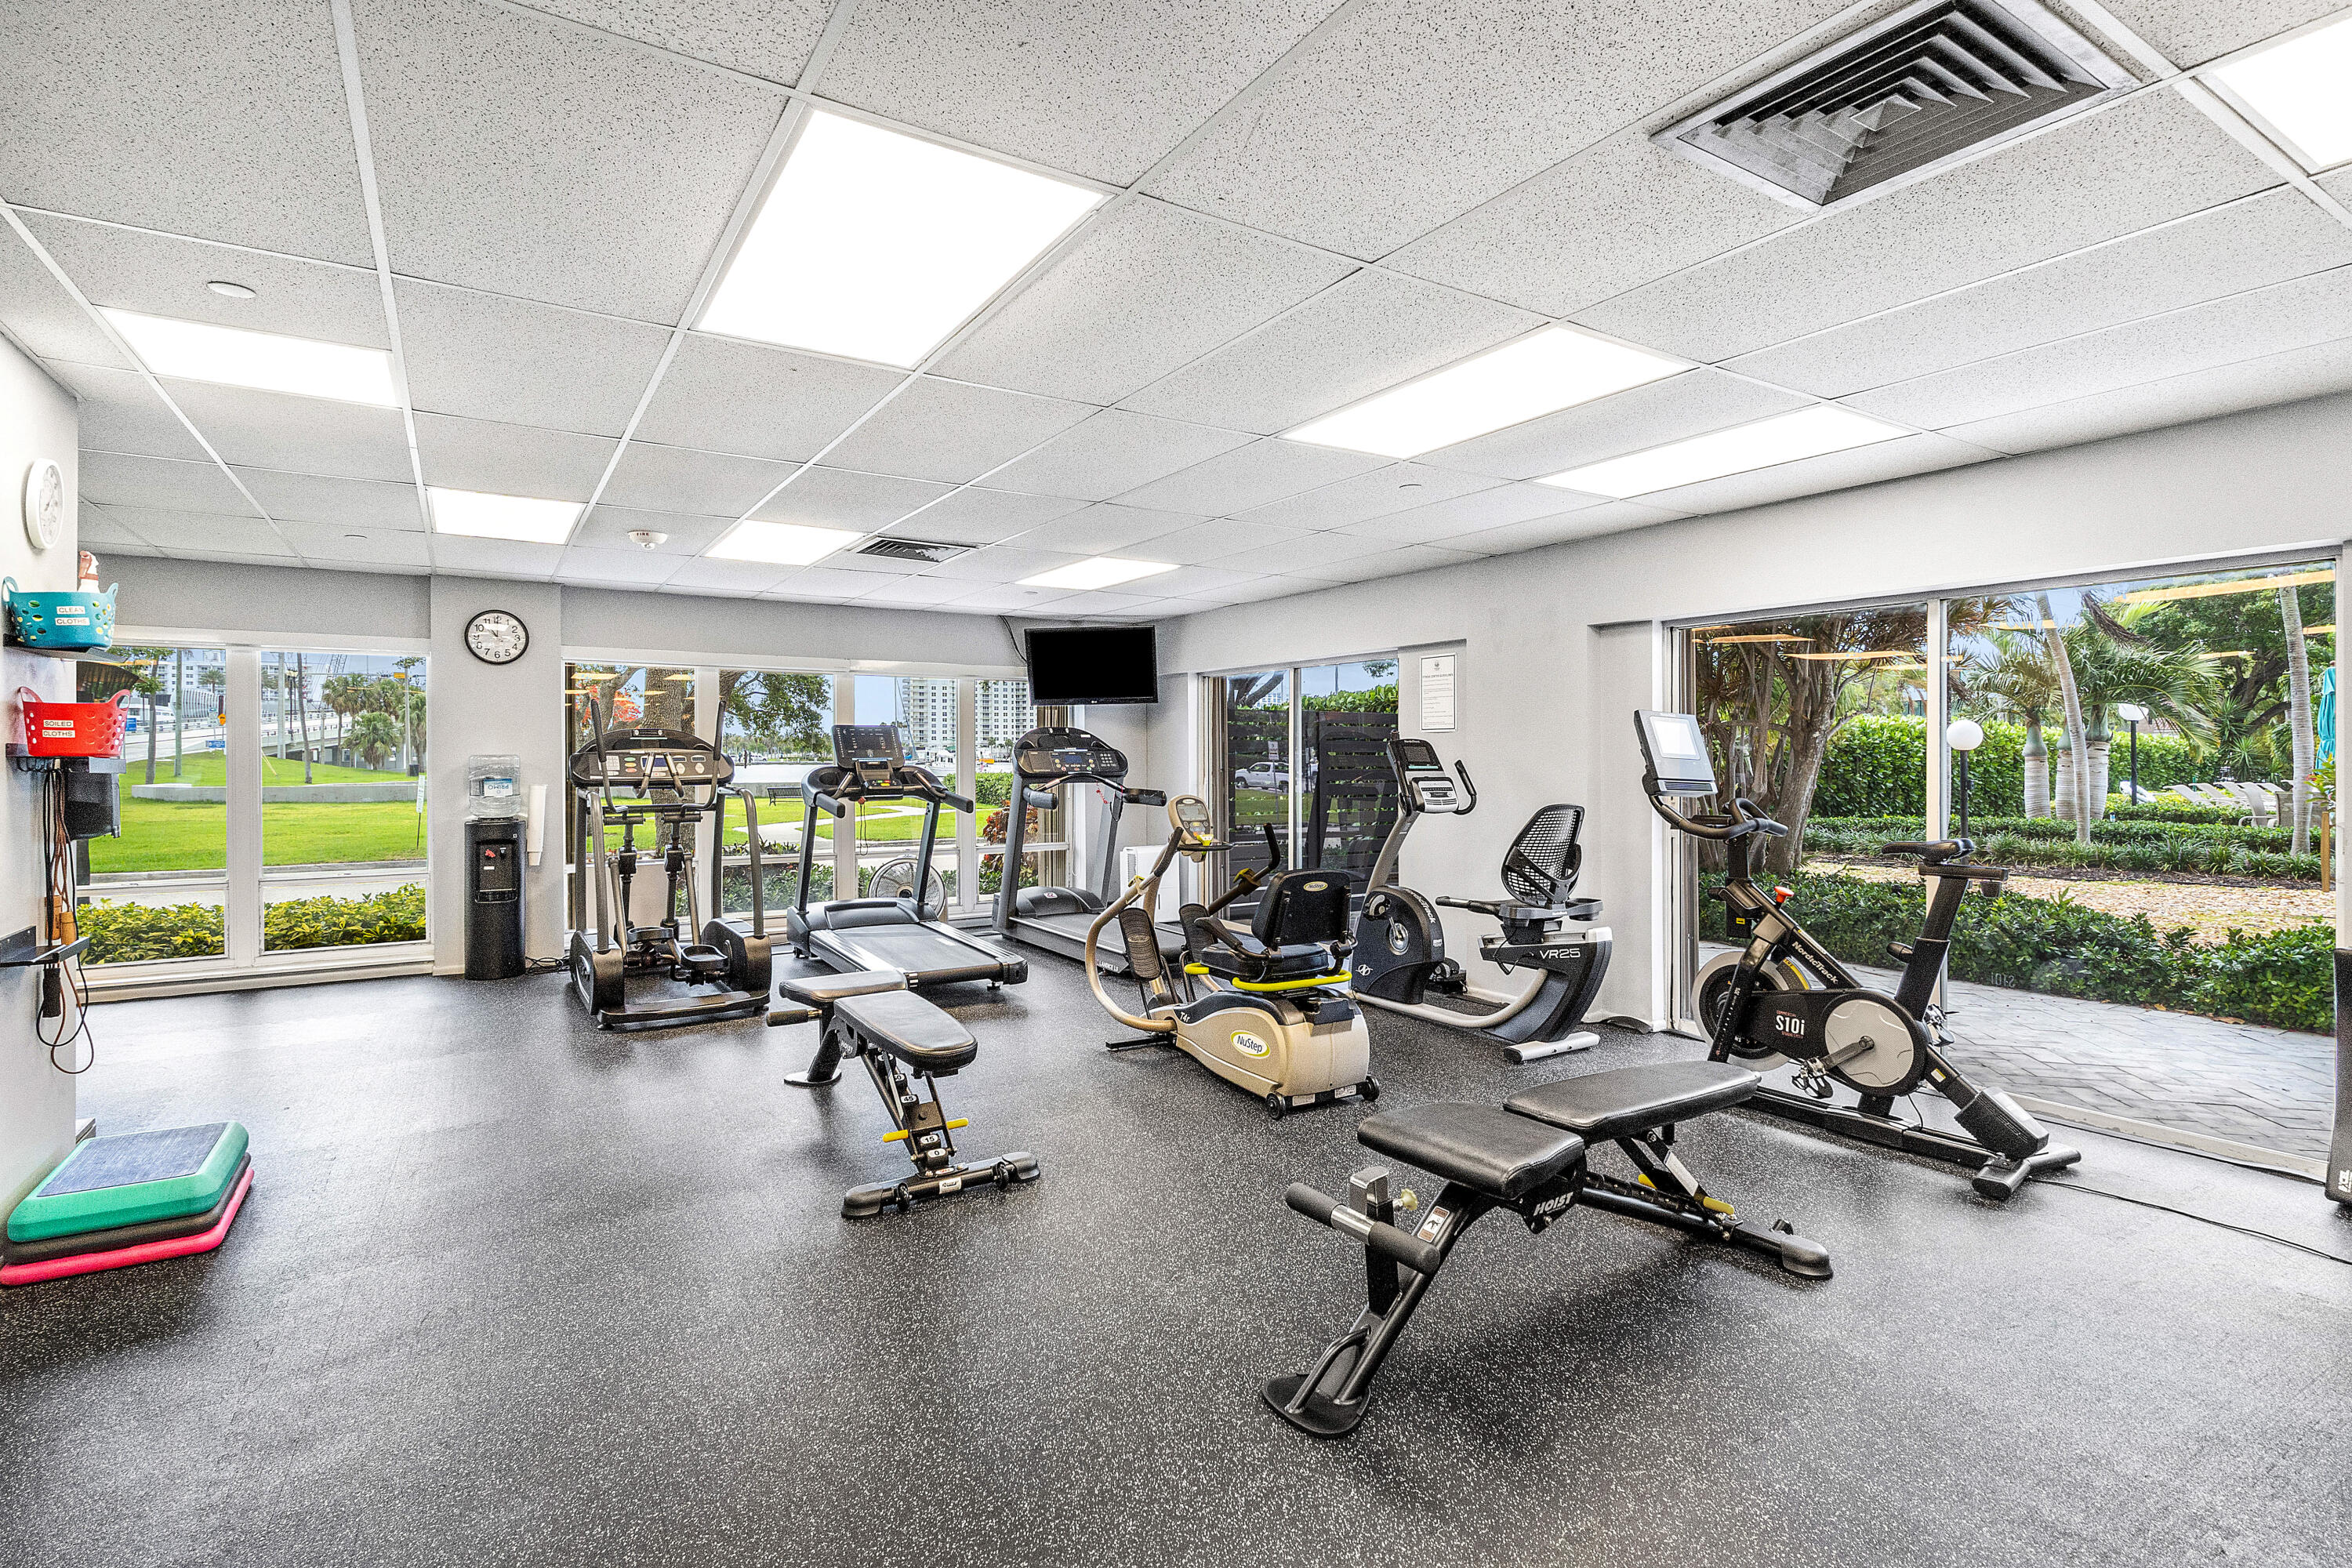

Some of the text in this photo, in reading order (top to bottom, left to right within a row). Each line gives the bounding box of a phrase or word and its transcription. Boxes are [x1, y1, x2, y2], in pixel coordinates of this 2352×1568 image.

[1540, 948, 1581, 960] VR25
[1792, 941, 1838, 984] NordicTrack
[1180, 1012, 1190, 1022] T4r
[1776, 1014, 1805, 1035] S10i
[1236, 1035, 1262, 1053] NuStep
[1533, 1192, 1573, 1217] HOIST
